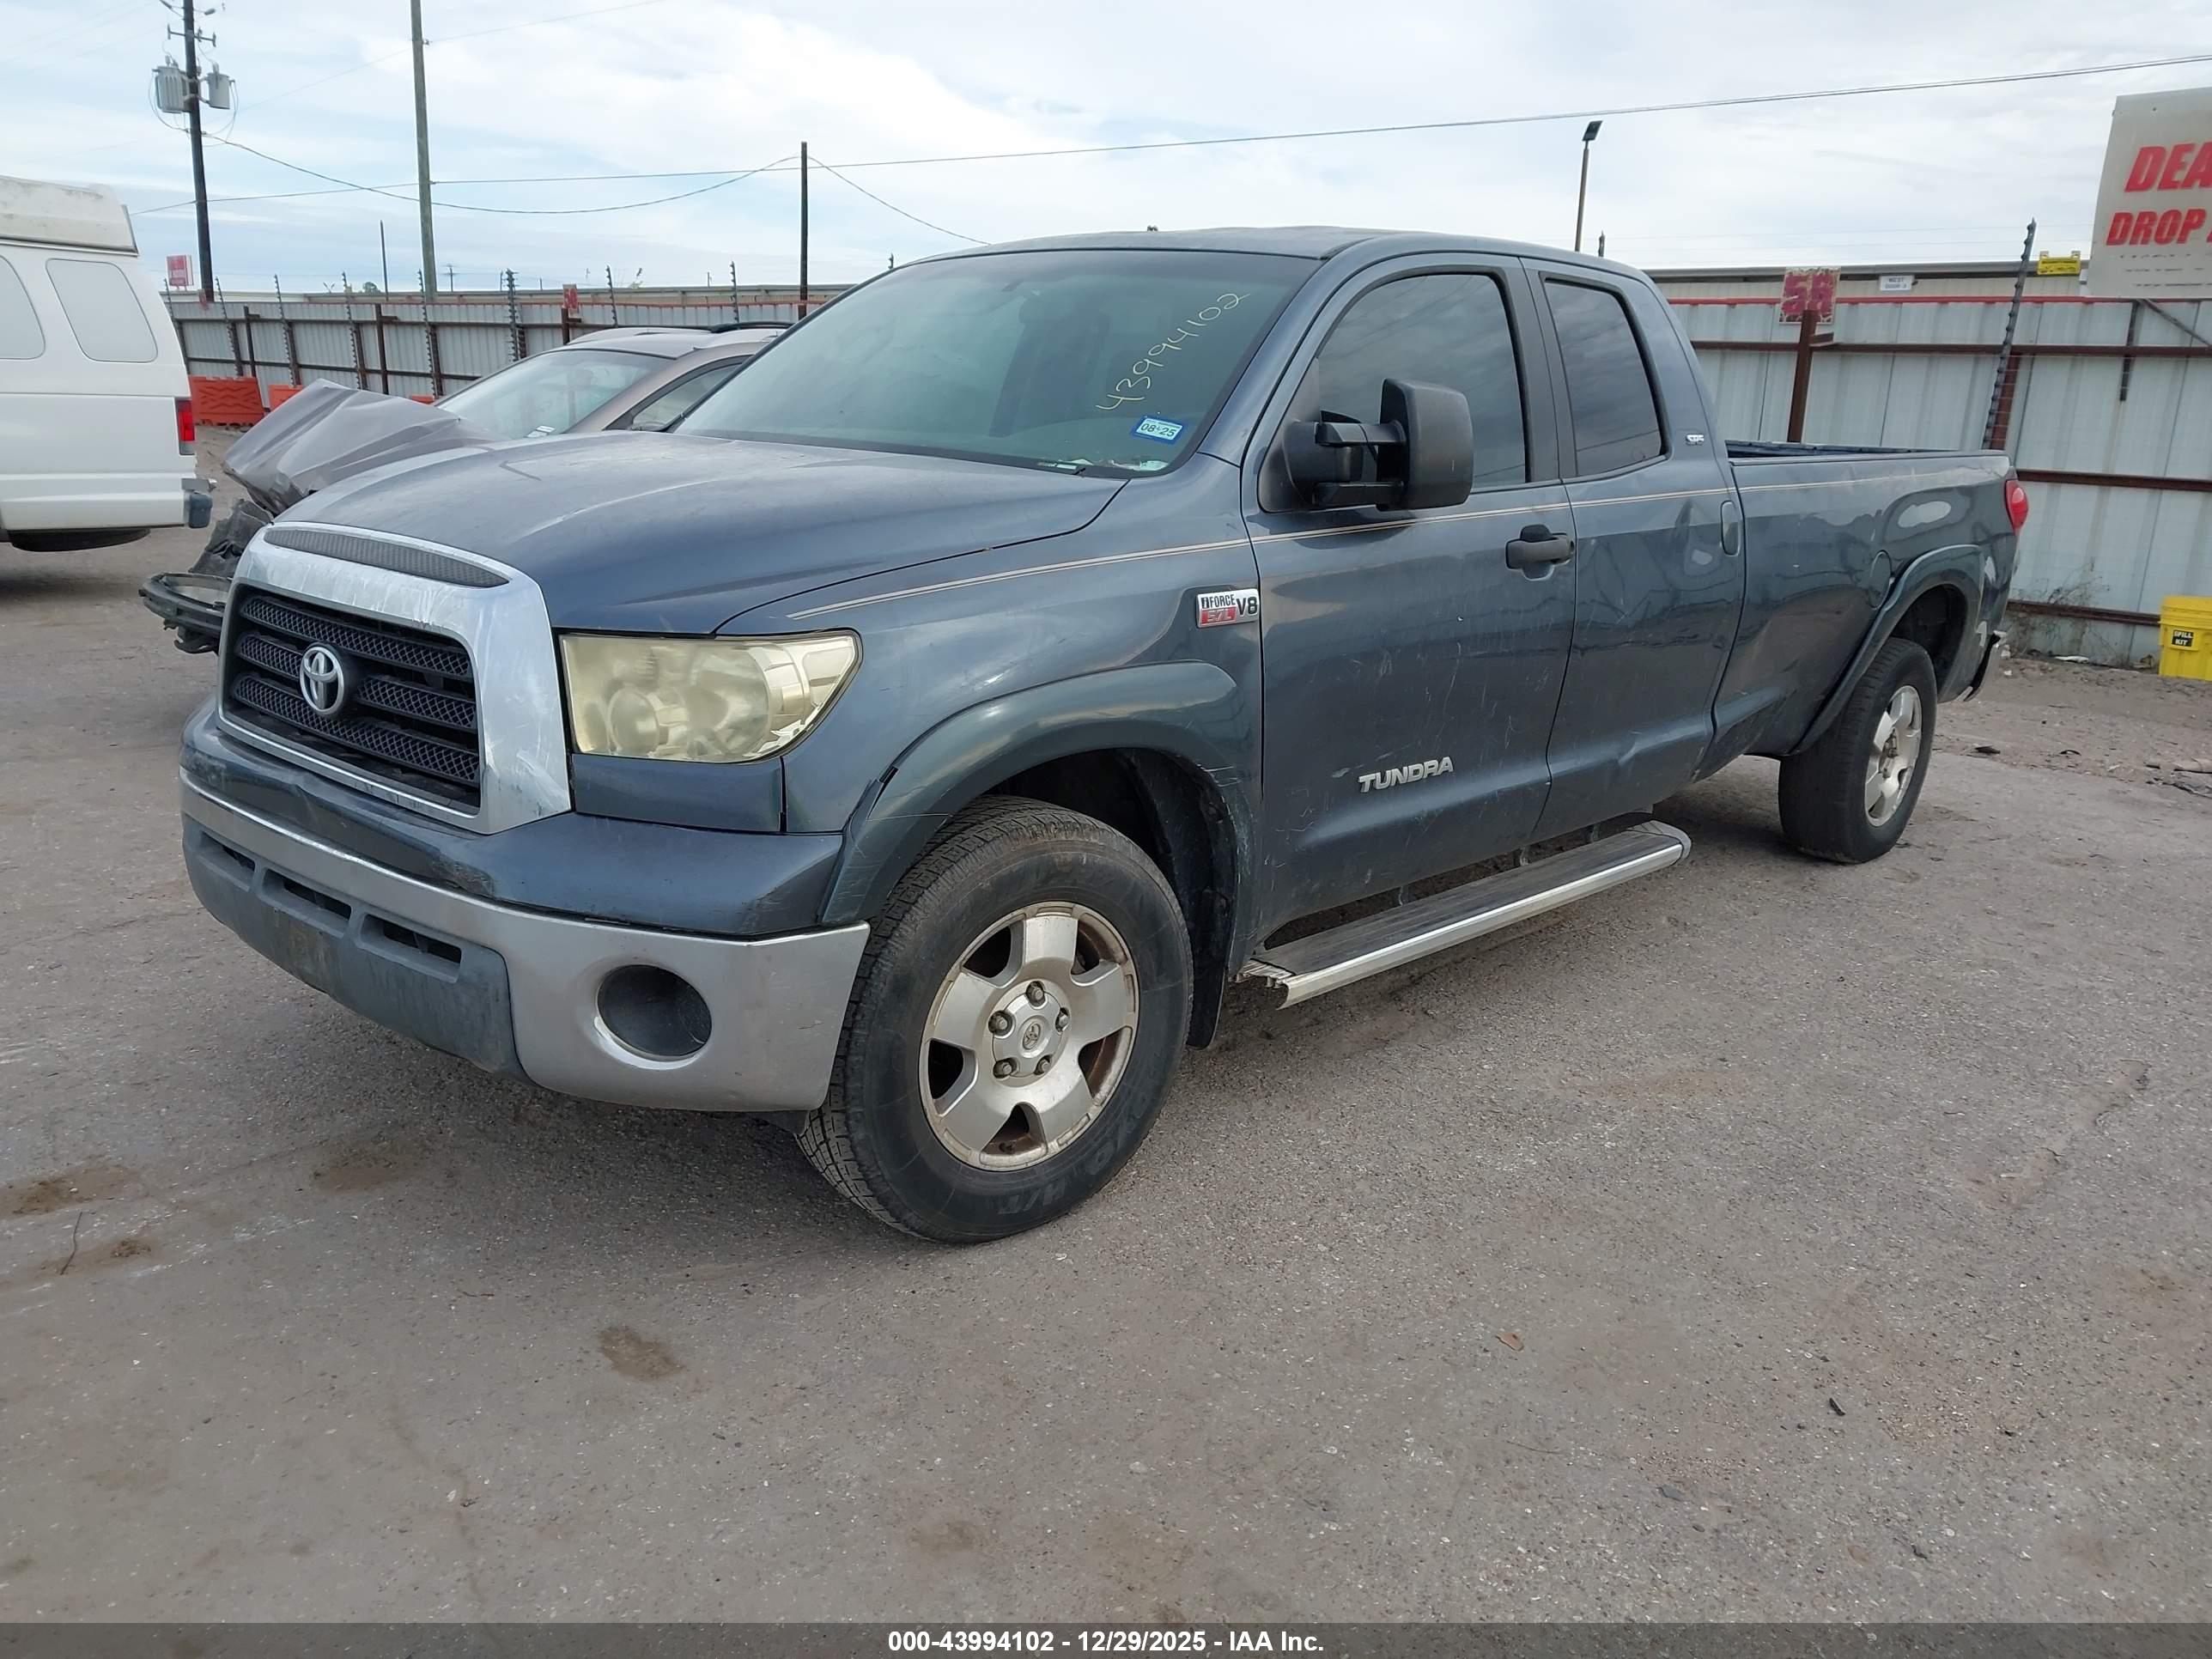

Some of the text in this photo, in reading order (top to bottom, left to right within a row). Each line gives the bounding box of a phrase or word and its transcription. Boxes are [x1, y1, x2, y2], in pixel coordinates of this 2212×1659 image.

[2106, 209, 2207, 246] DROP
[1096, 293, 1250, 410] 43994102
[1140, 423, 1157, 433] 08
[1159, 427, 1177, 437] 25
[1237, 596, 1258, 616] V8
[2173, 630, 2194, 639] SPILL
[1358, 757, 1454, 793] TUNDRA
